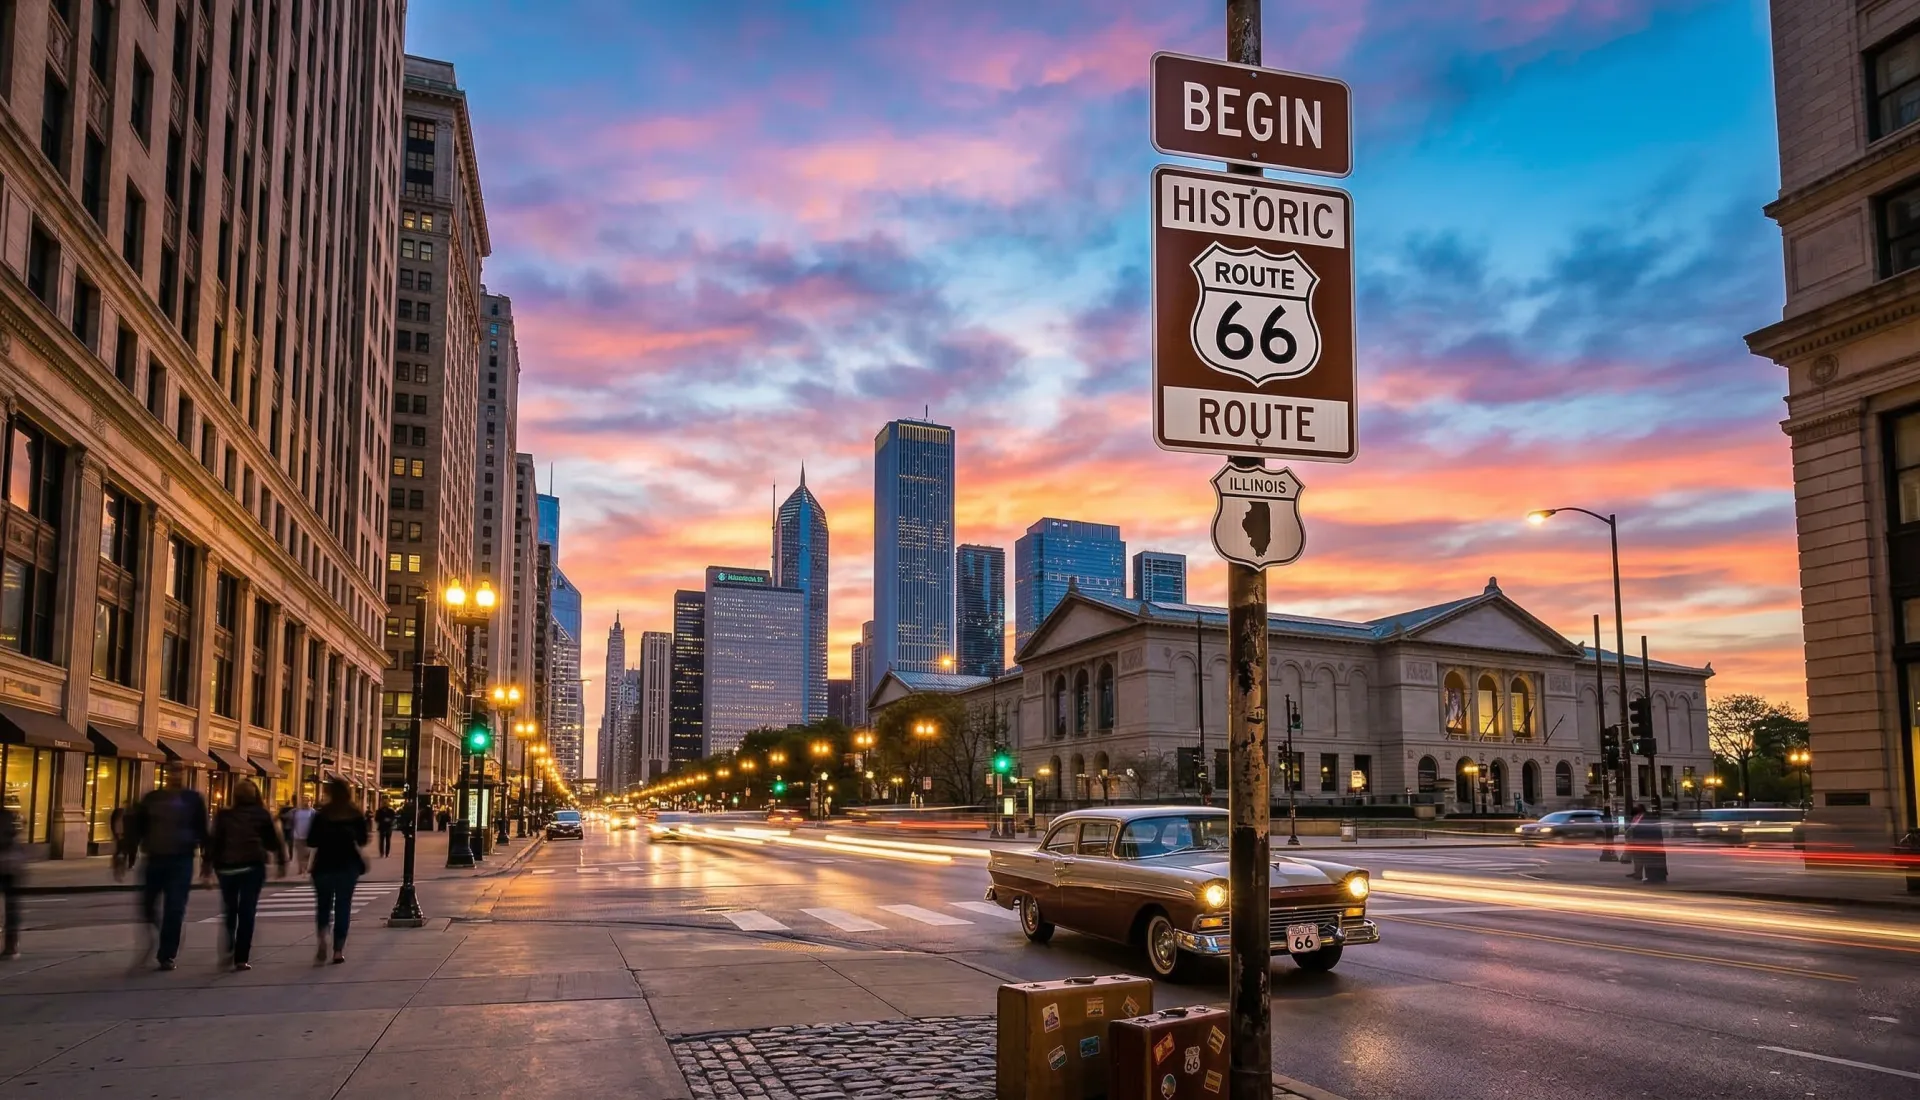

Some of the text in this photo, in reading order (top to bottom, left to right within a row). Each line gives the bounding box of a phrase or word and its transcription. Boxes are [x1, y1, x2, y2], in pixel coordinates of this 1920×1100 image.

[1184, 81, 1322, 149] BEGIN
[1173, 185, 1334, 239] HISTORIC
[1215, 261, 1295, 290] ROUTE
[1216, 300, 1297, 364] 66
[1199, 398, 1315, 443] ROUTE
[1229, 476, 1287, 494] ILLINOIS
[1295, 935, 1313, 950] 66
[1186, 1057, 1199, 1072] 66
